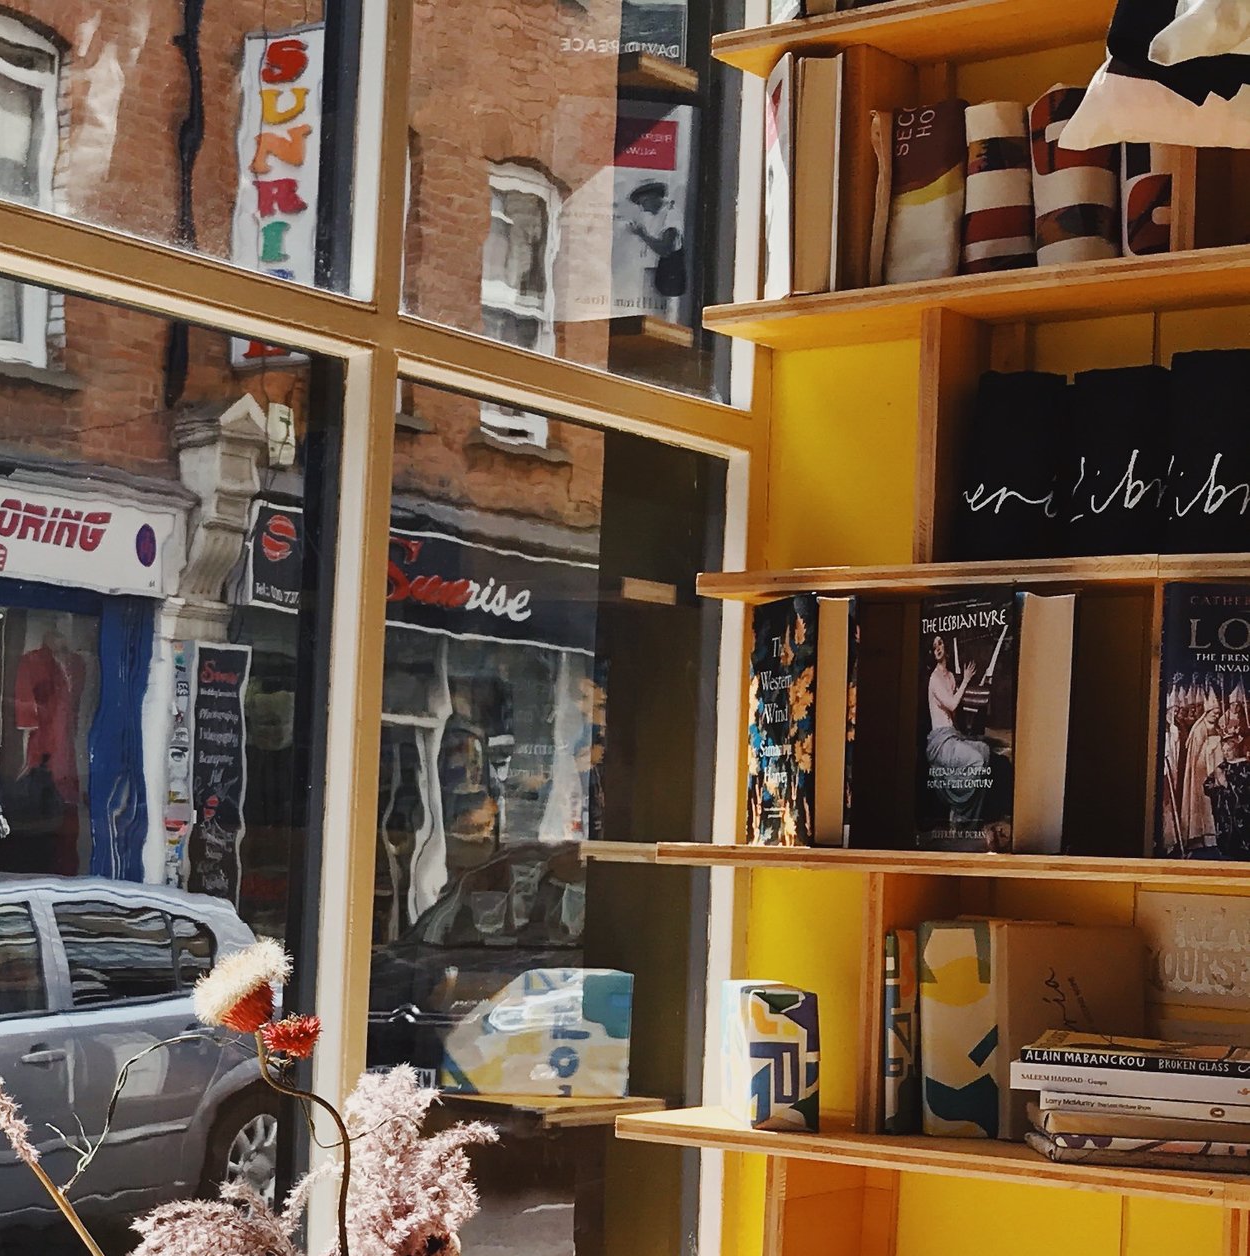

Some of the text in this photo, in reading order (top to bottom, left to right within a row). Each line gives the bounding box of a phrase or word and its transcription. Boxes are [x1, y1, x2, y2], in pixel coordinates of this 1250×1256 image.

[916, 105, 936, 138] HO
[922, 608, 1006, 634] THE LESBIAN LYRE
[1196, 653, 1216, 661] THE
[760, 671, 793, 691] Western
[763, 703, 789, 724] Wind
[1025, 1050, 1229, 1073] ALAIN MABANCKOU BROKEN GLASS
[1021, 1073, 1049, 1082] SALEEM
[1051, 1074, 1084, 1084] HADDAD
